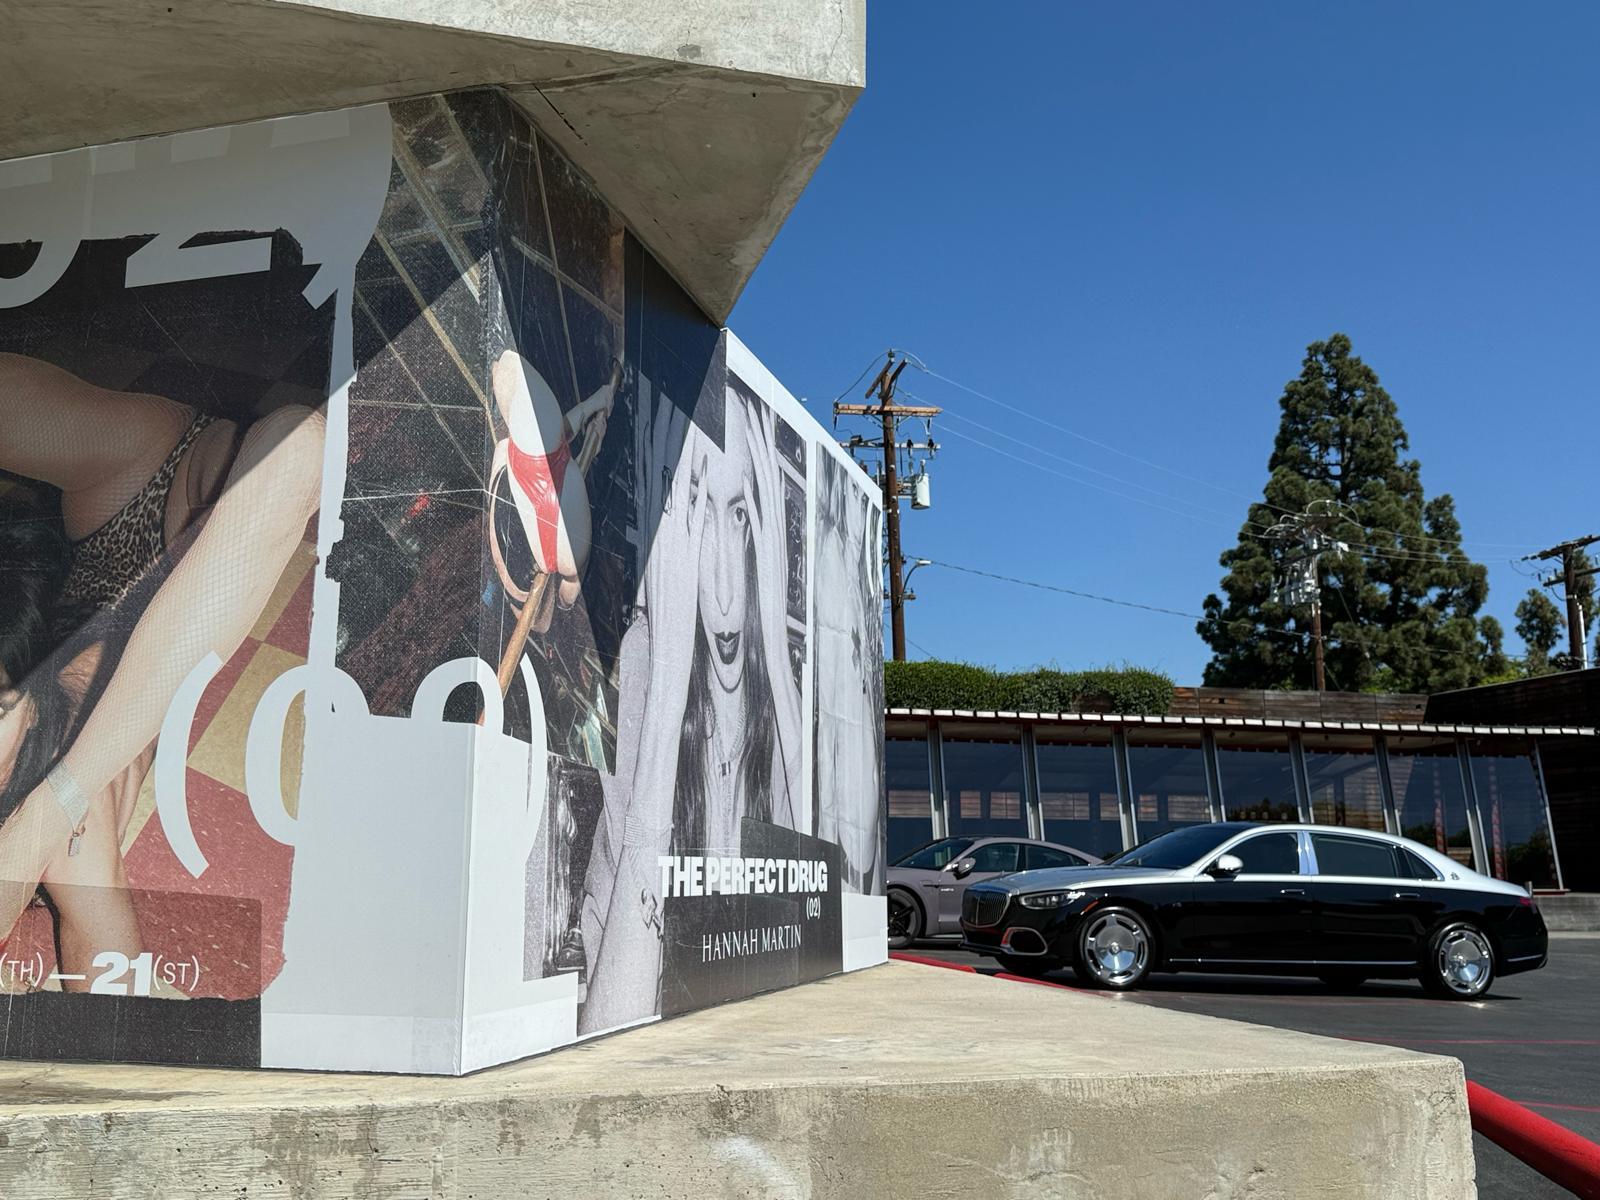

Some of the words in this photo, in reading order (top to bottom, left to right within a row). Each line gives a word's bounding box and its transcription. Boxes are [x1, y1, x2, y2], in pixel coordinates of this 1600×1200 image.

[657, 855, 704, 898] THE
[705, 856, 787, 896] PERFECT
[787, 859, 828, 893] DRUG
[806, 896, 821, 920] (02)
[702, 928, 758, 963] HANNAH
[761, 924, 802, 953] MARTIN
